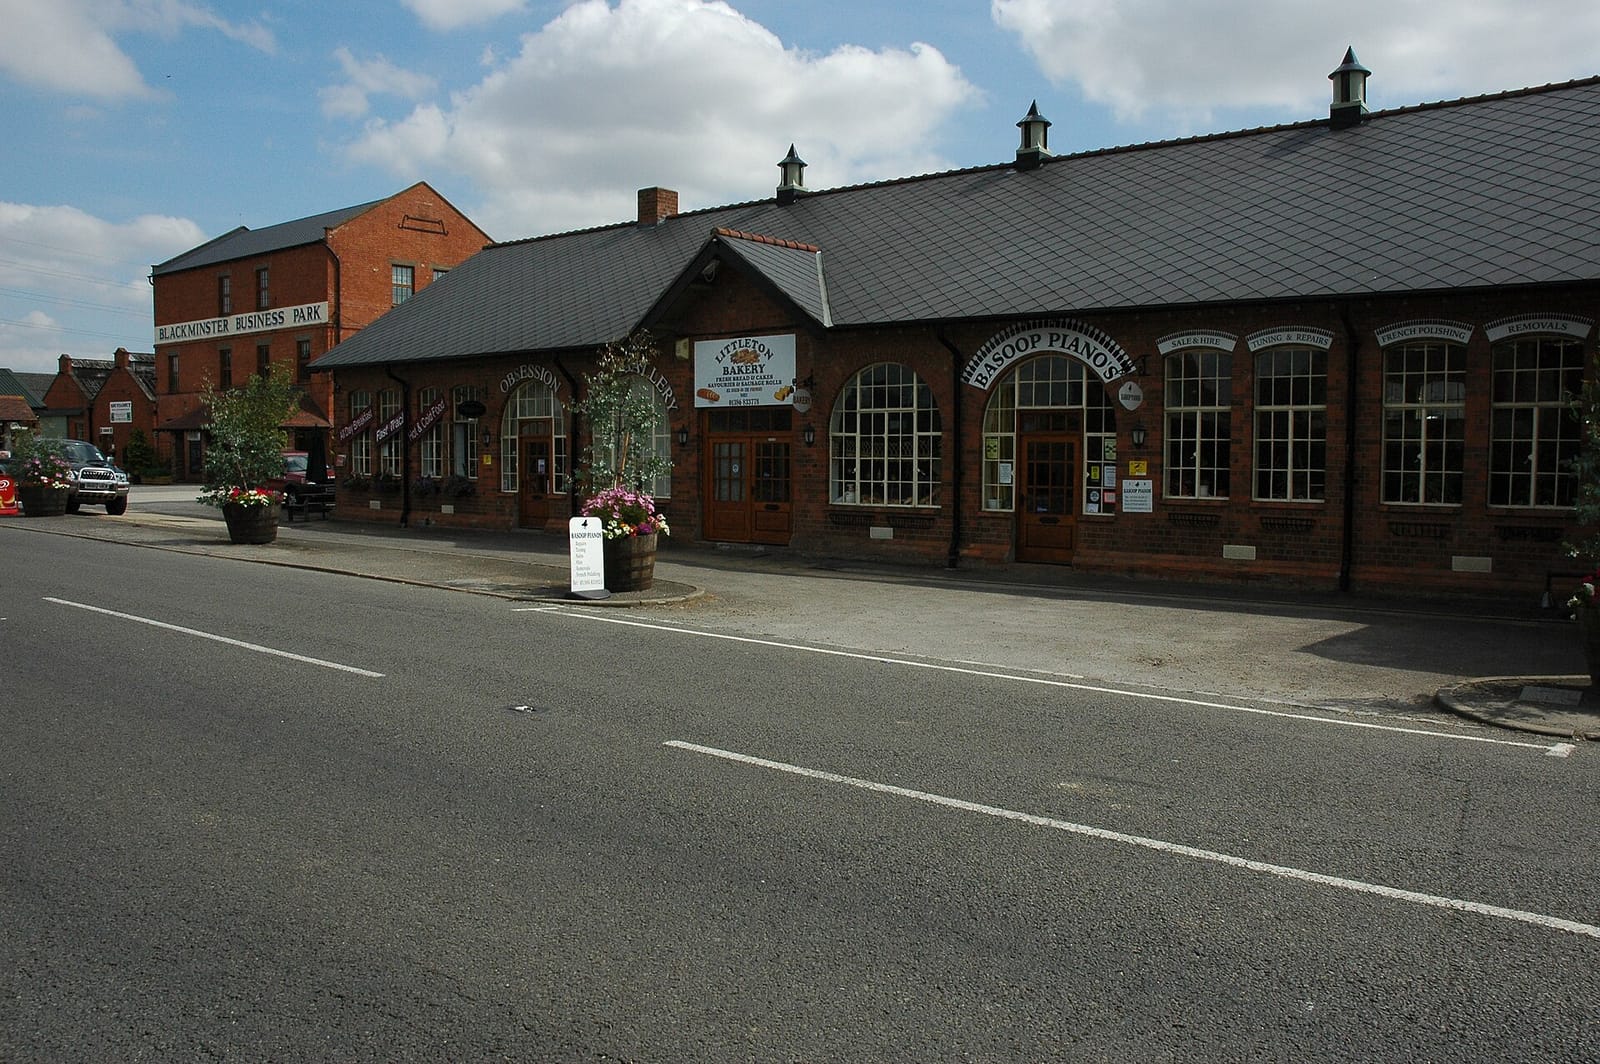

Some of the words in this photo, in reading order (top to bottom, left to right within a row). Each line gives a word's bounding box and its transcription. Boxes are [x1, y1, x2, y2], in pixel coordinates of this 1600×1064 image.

[159, 319, 229, 340] BLACKMINSTER
[236, 311, 285, 330] BUSINESS
[293, 305, 321, 323] PARK
[1507, 322, 1568, 334] REMOVALS
[1171, 337, 1192, 347] SALE
[1200, 337, 1221, 346] HIRE
[1251, 333, 1282, 348] TUNING
[1296, 333, 1329, 346] REPAIRS
[1381, 327, 1416, 343] FRENCH
[1418, 326, 1466, 340] POLISHING
[715, 338, 774, 364] LITTLETON
[974, 333, 1042, 388] BASOOP
[1047, 332, 1119, 380] PIANO'S
[500, 364, 561, 393] OBSESSION
[722, 364, 766, 376] BAKERY
[408, 428, 418, 441] Hot
[421, 411, 433, 429] Cold
[432, 399, 445, 418] Food
